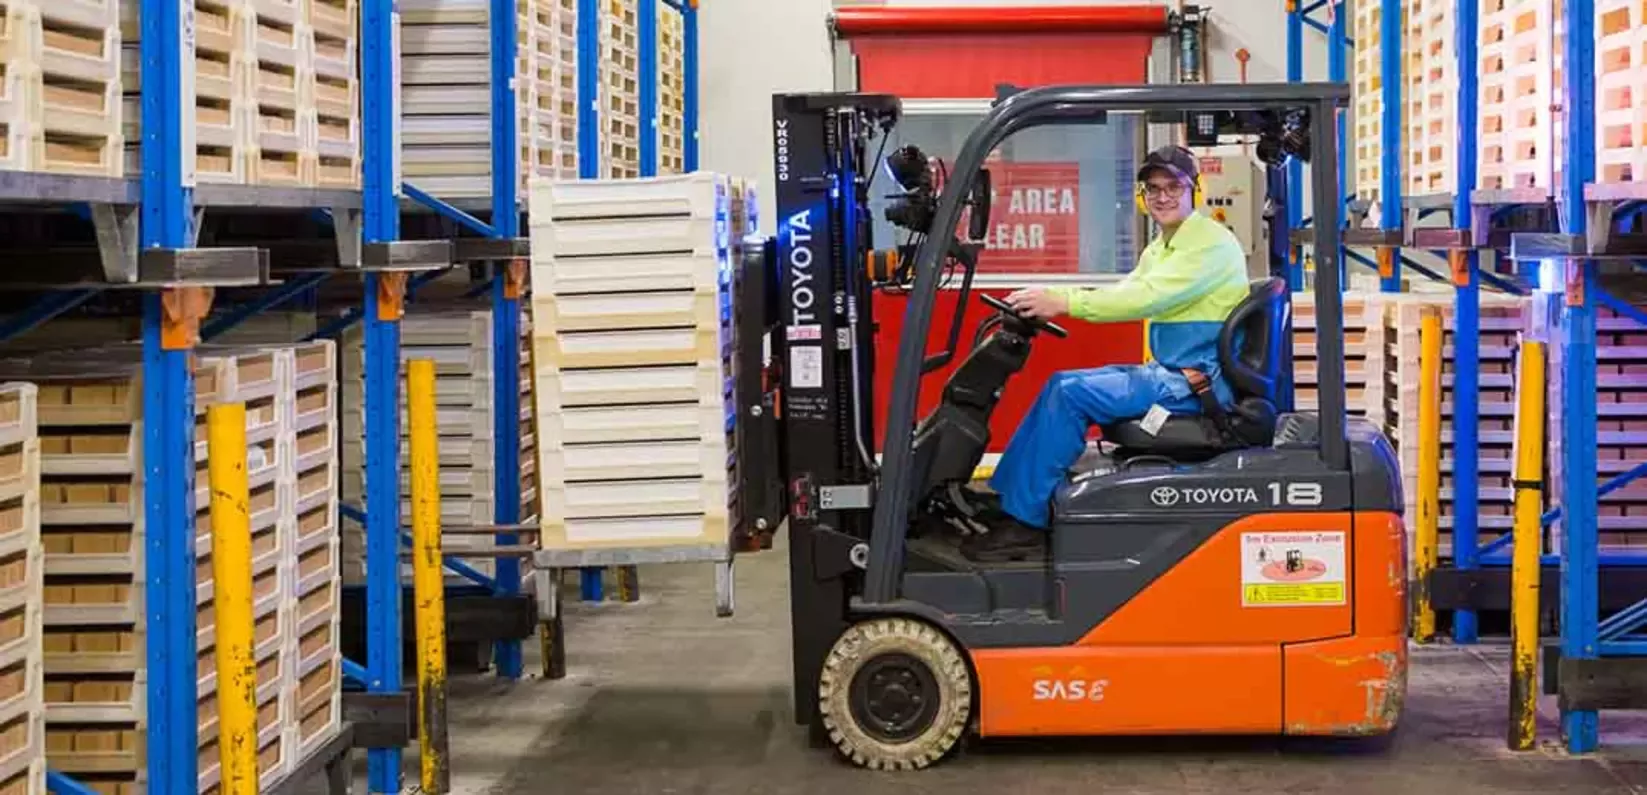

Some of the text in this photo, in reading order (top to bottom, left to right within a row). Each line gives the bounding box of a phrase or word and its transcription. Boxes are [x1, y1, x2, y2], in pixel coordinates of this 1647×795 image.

[1008, 187, 1075, 215] AREA
[984, 223, 1045, 250] LEAR
[789, 209, 814, 326] TOYOTA
[1182, 482, 1323, 506] TOYOTA 18
